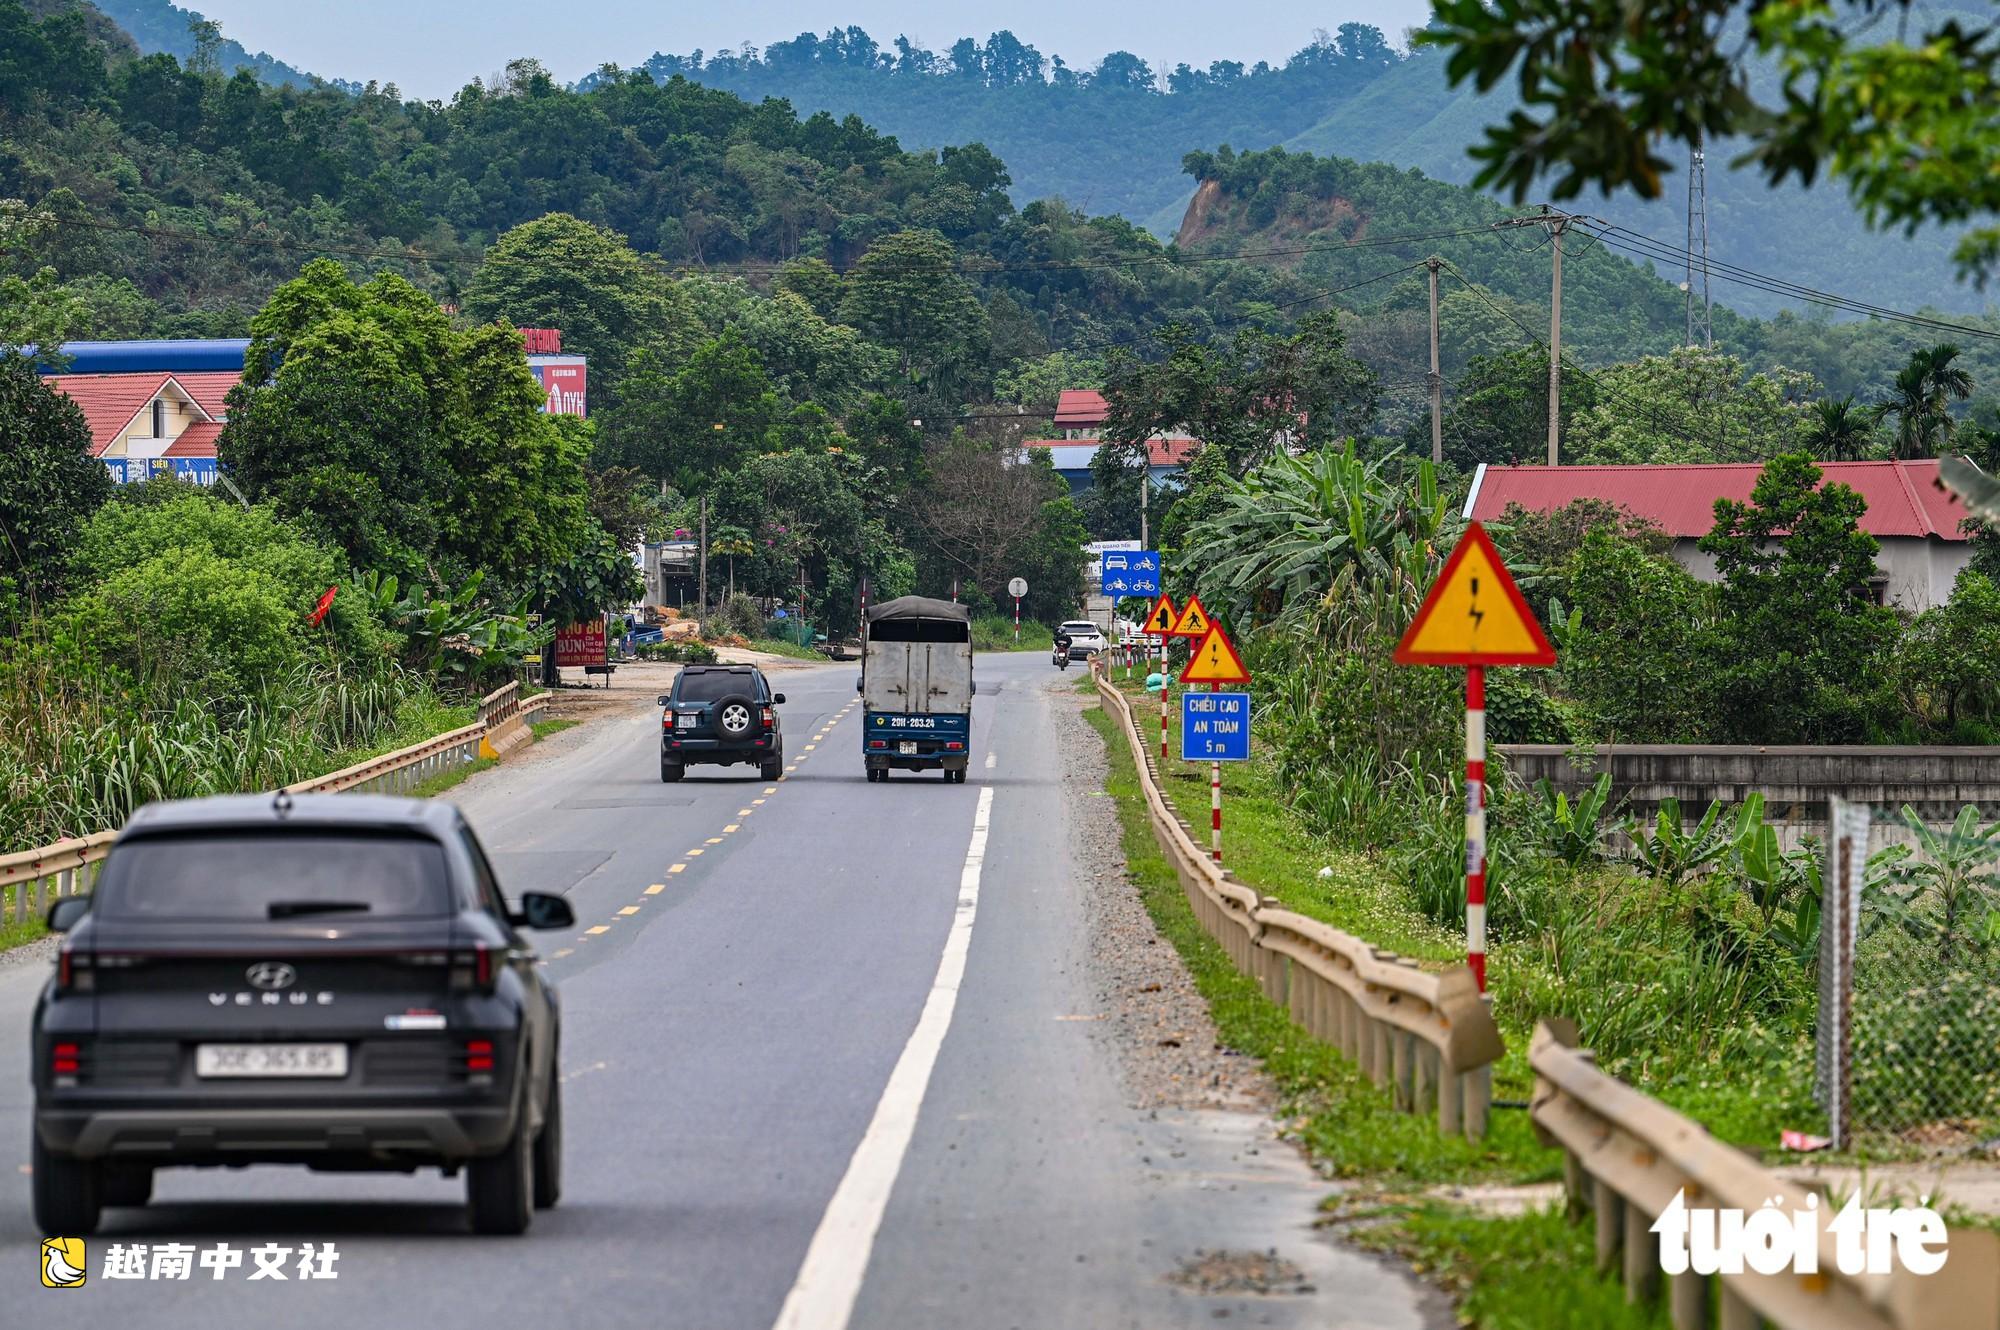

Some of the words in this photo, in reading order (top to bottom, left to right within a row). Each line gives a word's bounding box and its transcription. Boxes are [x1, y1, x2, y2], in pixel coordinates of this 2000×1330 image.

[1220, 700, 1239, 713] CAO
[1193, 720, 1208, 733] AN
[1213, 718, 1239, 733] TOÀN
[1206, 739, 1212, 753] 5
[1215, 743, 1225, 753] m
[208, 991, 335, 1006] VENUE
